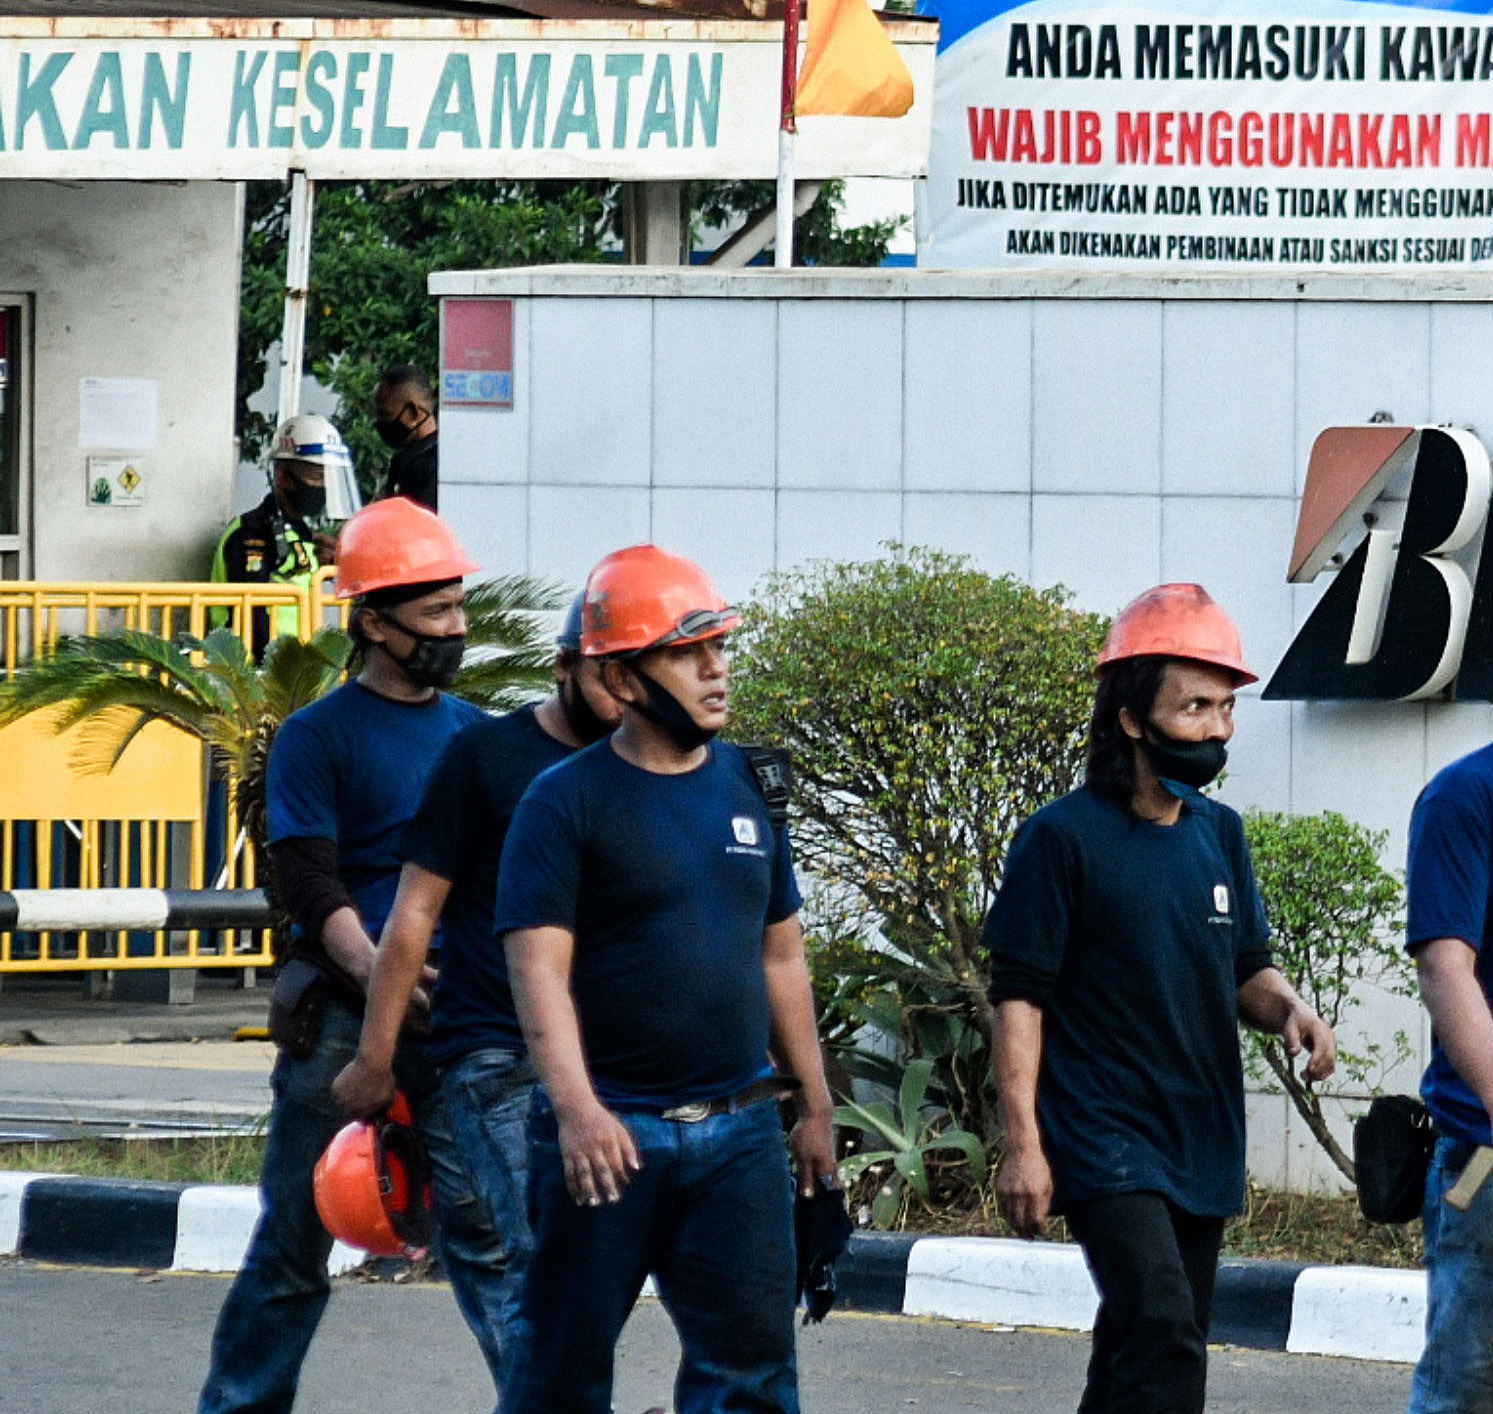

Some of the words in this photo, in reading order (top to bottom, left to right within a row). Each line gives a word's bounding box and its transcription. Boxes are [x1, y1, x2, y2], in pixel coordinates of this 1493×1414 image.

[1005, 23, 1122, 79] ANDA
[1134, 24, 1366, 81] MEMASUKI
[0, 51, 192, 151] KAN
[226, 50, 724, 150] KESELAMATAN
[967, 107, 1103, 165] WAJIB
[1116, 111, 1442, 168] MENGGUNAKAN
[957, 179, 1006, 209] JIKA
[1012, 182, 1147, 215] DITEMUKAN
[1154, 186, 1200, 216] ADA
[1208, 187, 1268, 217] YANG
[1276, 188, 1347, 218] TIDAK
[1006, 230, 1055, 254] AKAN
[1060, 232, 1161, 259] DIKENAKAN
[1167, 235, 1274, 262] PEMBINAAN
[1279, 237, 1324, 262] ATAU
[1330, 238, 1398, 263] SANKSI
[1403, 238, 1465, 263] SESUAI
